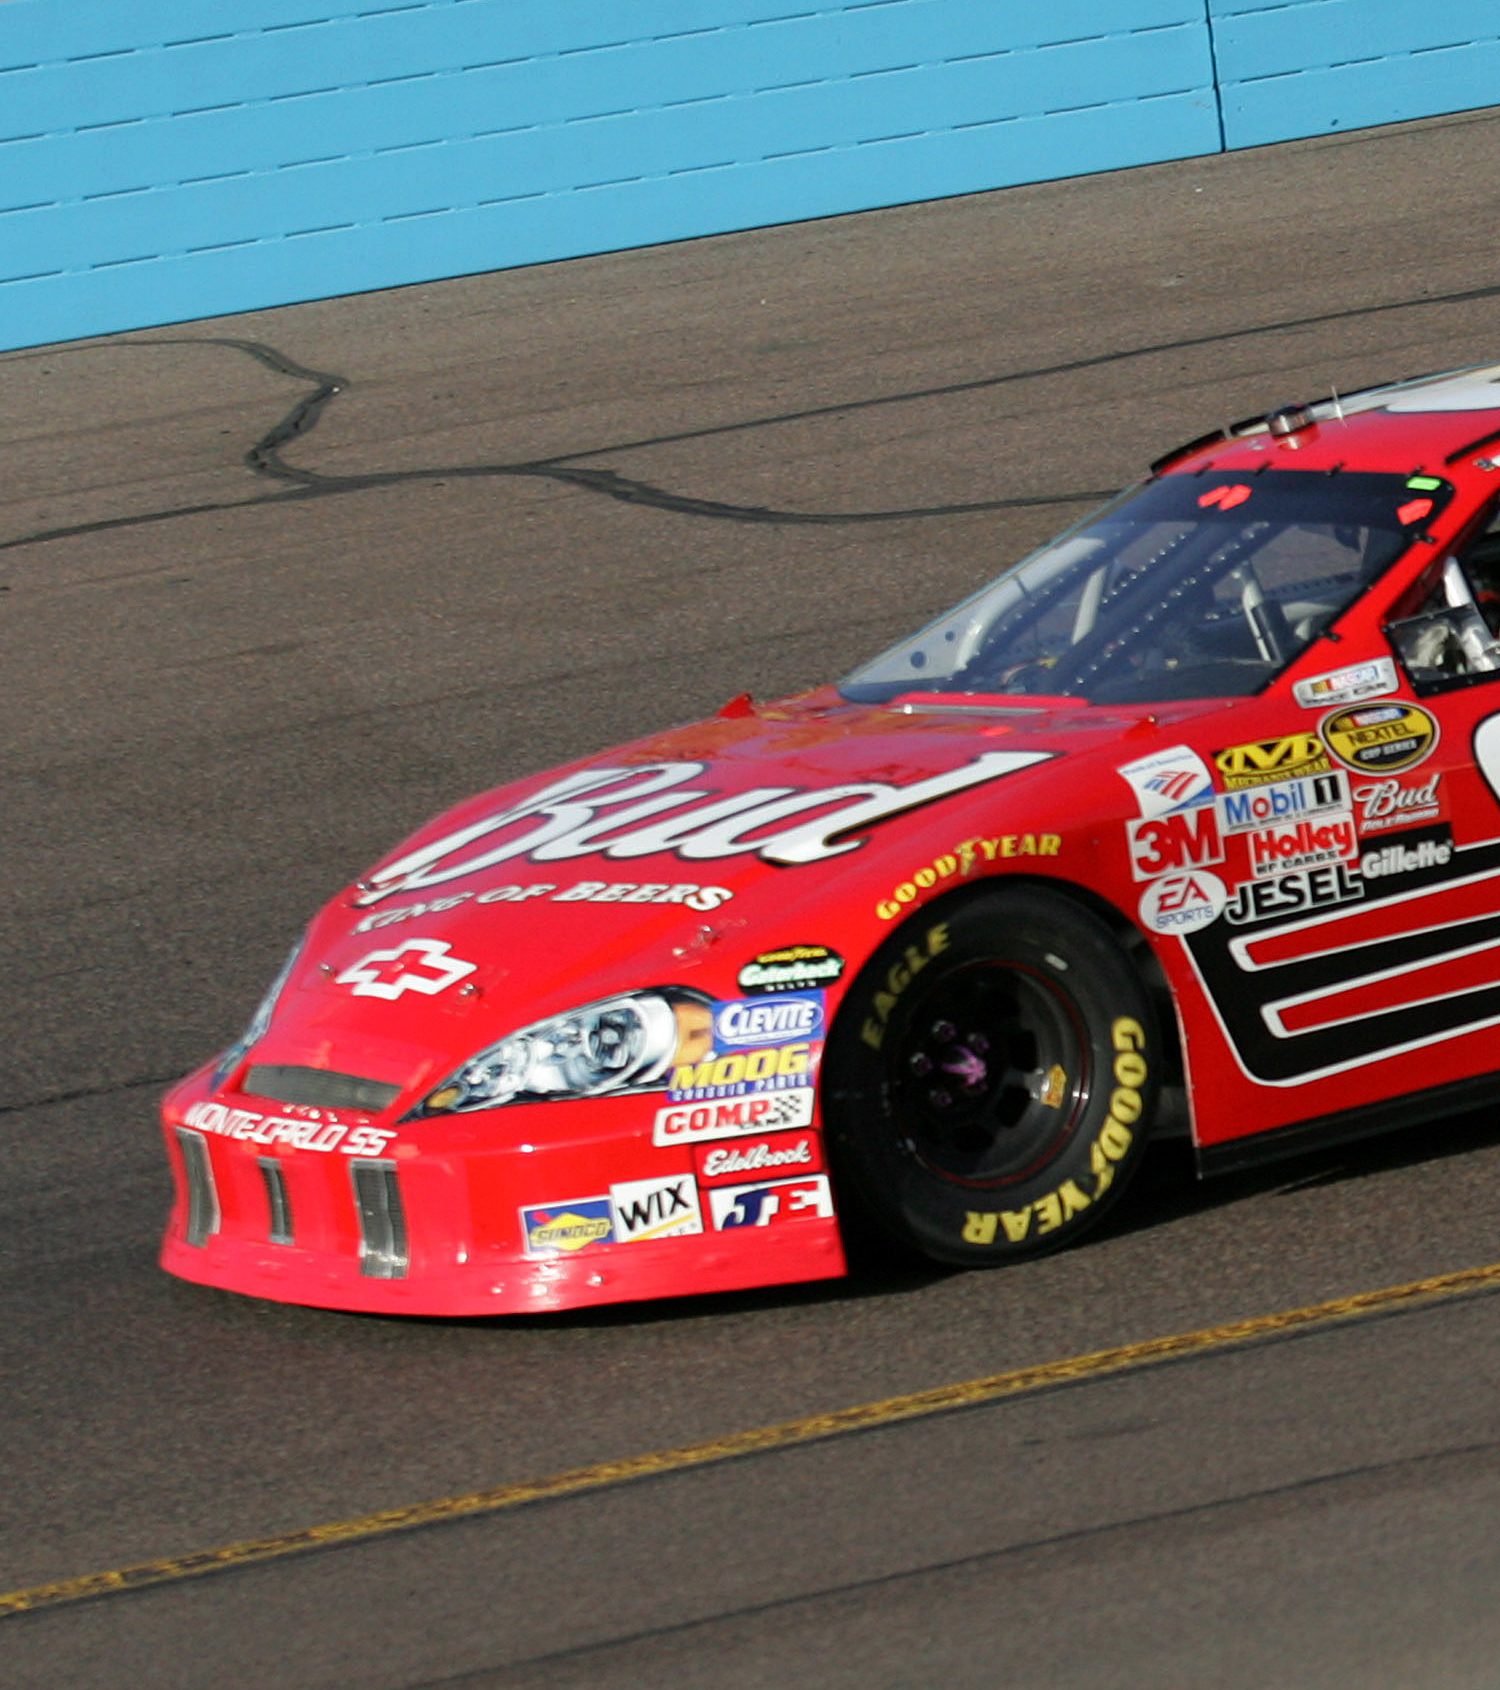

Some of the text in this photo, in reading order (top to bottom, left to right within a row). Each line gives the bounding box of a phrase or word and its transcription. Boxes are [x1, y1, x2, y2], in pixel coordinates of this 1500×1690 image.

[1349, 723, 1414, 746] NEXTEL
[1224, 782, 1305, 825] Mobil
[1353, 773, 1440, 819] Bud
[354, 750, 1056, 906] Bud
[1136, 808, 1222, 874] 3M
[1253, 822, 1354, 864] Holley
[876, 834, 1061, 920] GOODYEAR
[1362, 841, 1452, 879] Gillette
[477, 884, 557, 903] OF
[551, 881, 733, 911] BEERS
[1158, 877, 1210, 912] EA
[1227, 864, 1364, 922] JESEL
[1156, 906, 1214, 929] SPORTS
[861, 922, 951, 1051] EAGLE
[669, 1043, 810, 1090] MOOG
[664, 1100, 771, 1135] COMP
[961, 1015, 1148, 1245] GOODYEAR
[340, 1126, 399, 1156] SS
[703, 1140, 812, 1177] Edelbrock
[618, 1180, 691, 1233] WIX
[533, 1219, 612, 1246] SUNOCO
